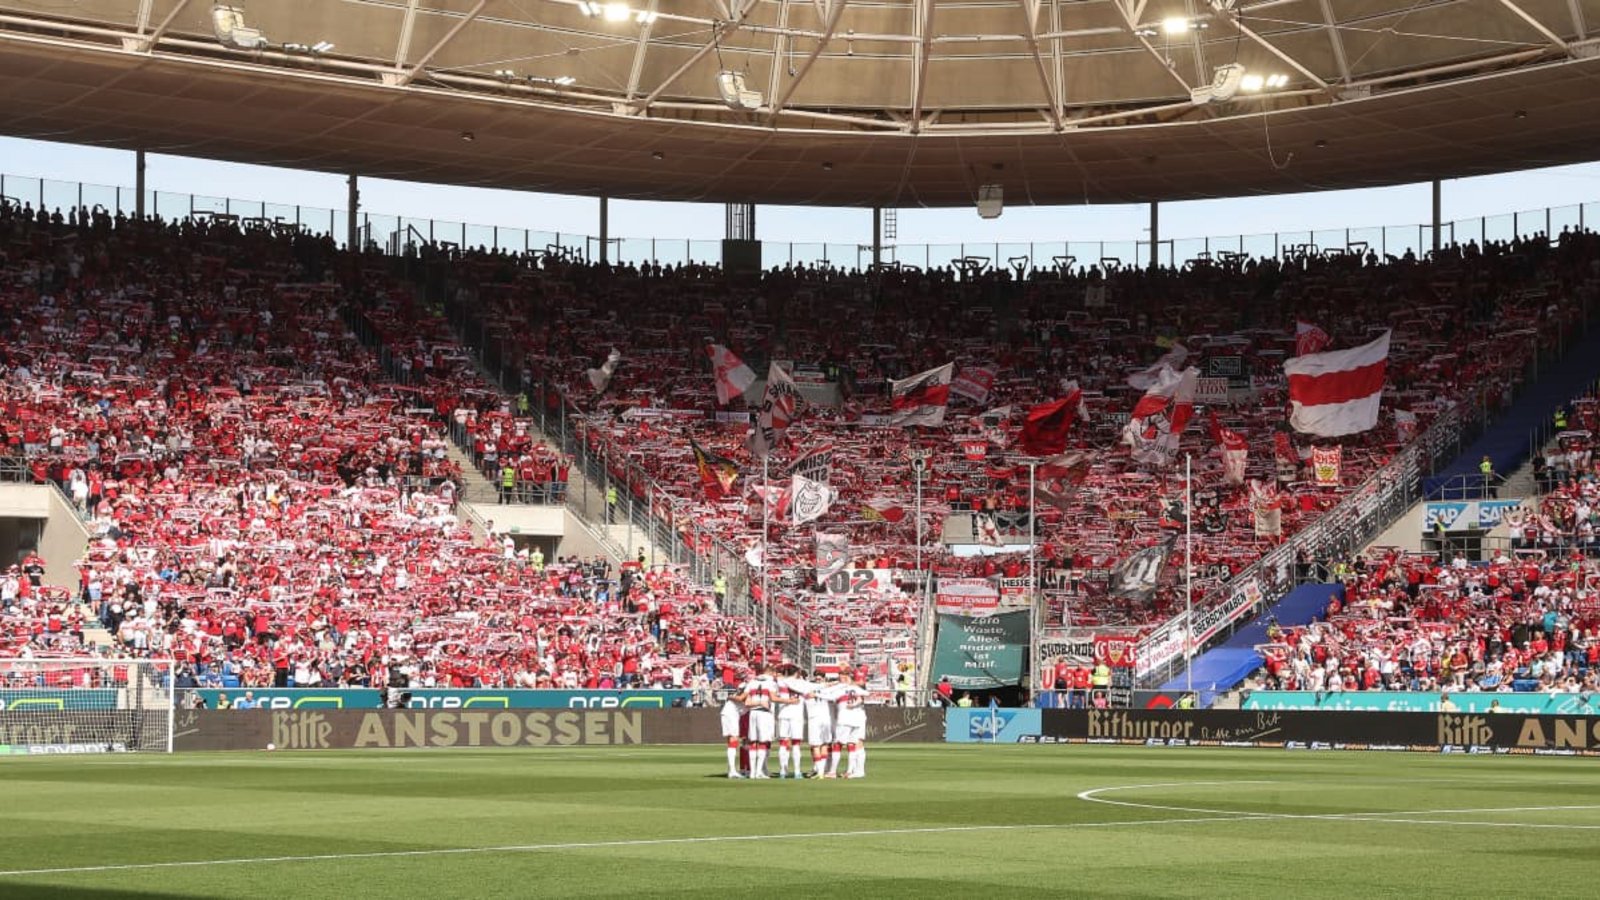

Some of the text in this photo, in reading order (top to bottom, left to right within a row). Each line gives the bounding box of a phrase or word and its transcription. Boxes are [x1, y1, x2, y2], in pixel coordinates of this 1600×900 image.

[1427, 507, 1458, 524] SAP
[272, 710, 642, 749] Bitte ANSTOSSEN
[970, 716, 1007, 735] SAP
[1517, 717, 1600, 748] AN
